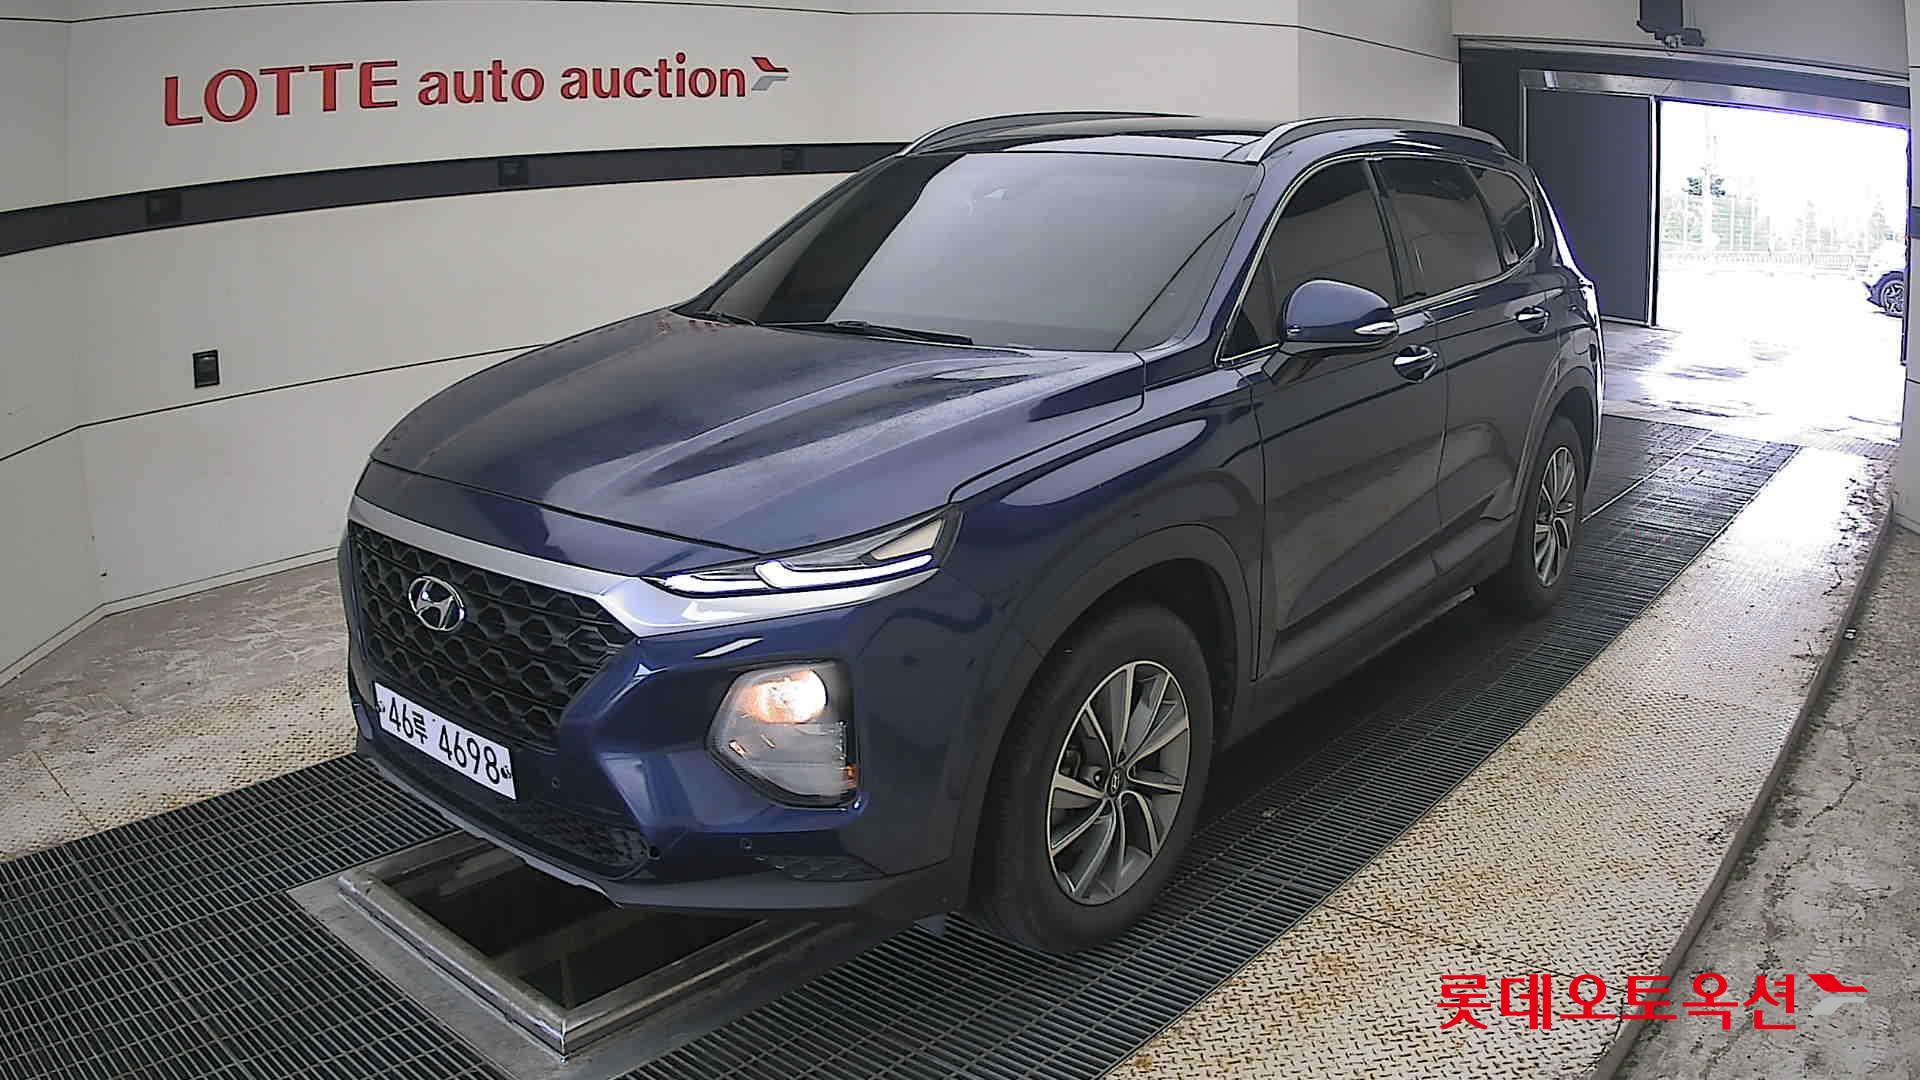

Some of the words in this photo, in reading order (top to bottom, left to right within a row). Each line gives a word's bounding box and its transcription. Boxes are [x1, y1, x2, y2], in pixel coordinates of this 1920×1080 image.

[164, 60, 398, 126] LOTTE
[417, 59, 545, 106] auto
[560, 52, 747, 99] auction
[389, 697, 428, 744] 46루
[438, 724, 500, 785] 4698
